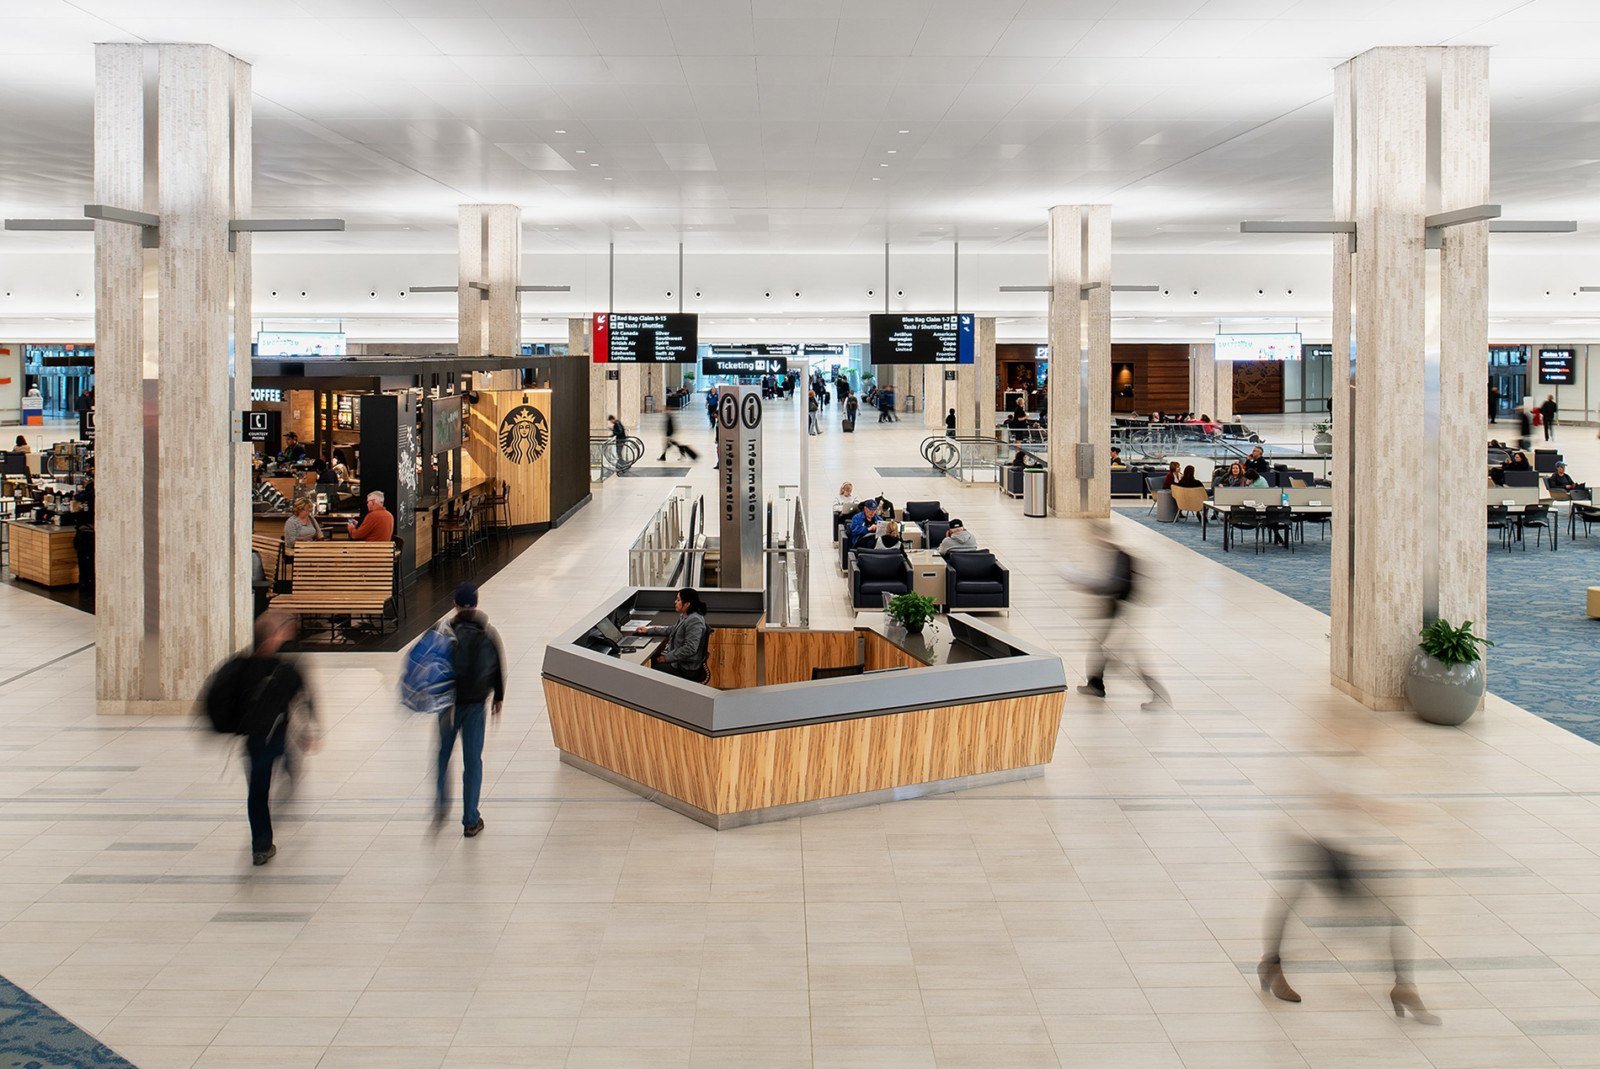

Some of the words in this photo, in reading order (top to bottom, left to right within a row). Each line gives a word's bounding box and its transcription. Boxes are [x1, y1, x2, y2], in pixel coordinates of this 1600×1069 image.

[717, 362, 754, 370] Ticketing
[251, 389, 280, 402] COFFEE
[726, 440, 734, 521] Information
[748, 439, 757, 521] Information
